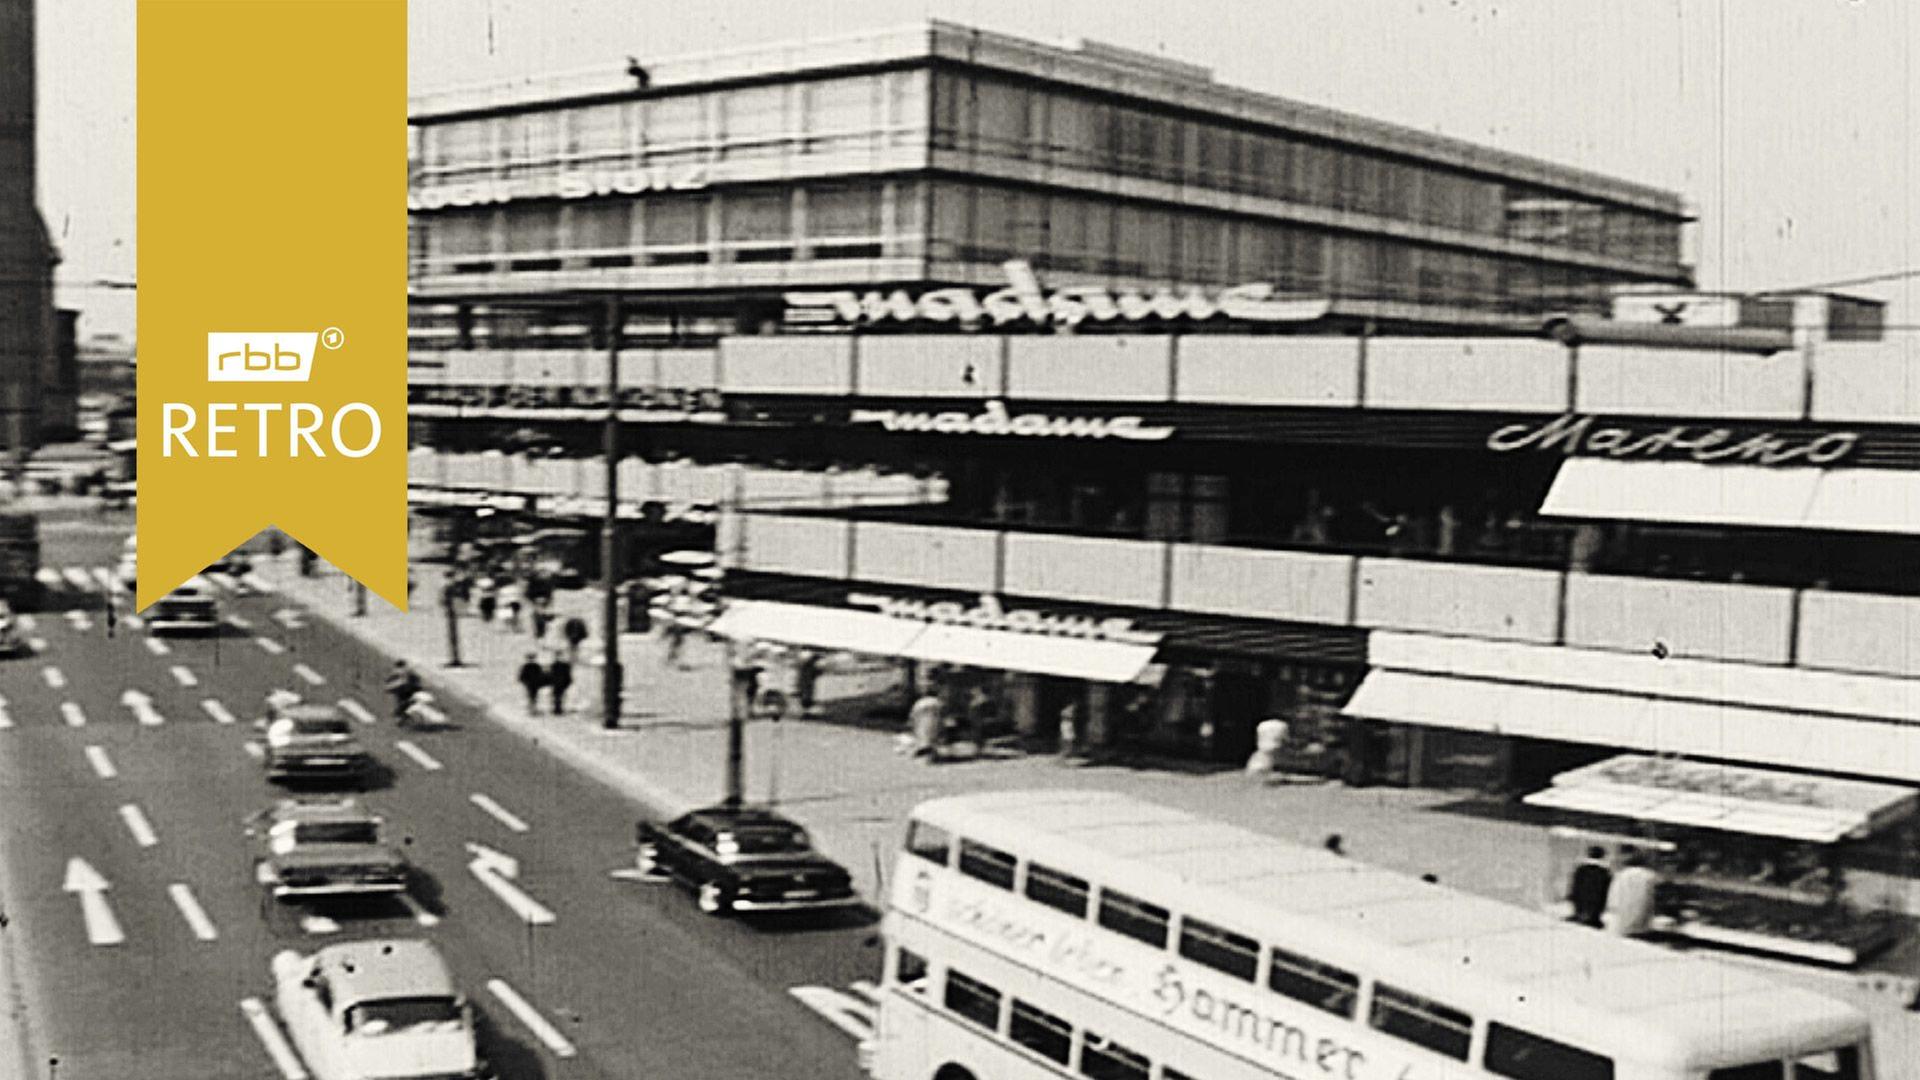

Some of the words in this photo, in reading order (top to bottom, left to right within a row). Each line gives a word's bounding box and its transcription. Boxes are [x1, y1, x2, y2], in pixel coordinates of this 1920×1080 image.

[783, 260, 1331, 325] madame
[850, 400, 1176, 440] madame
[847, 594, 1165, 644] madame
